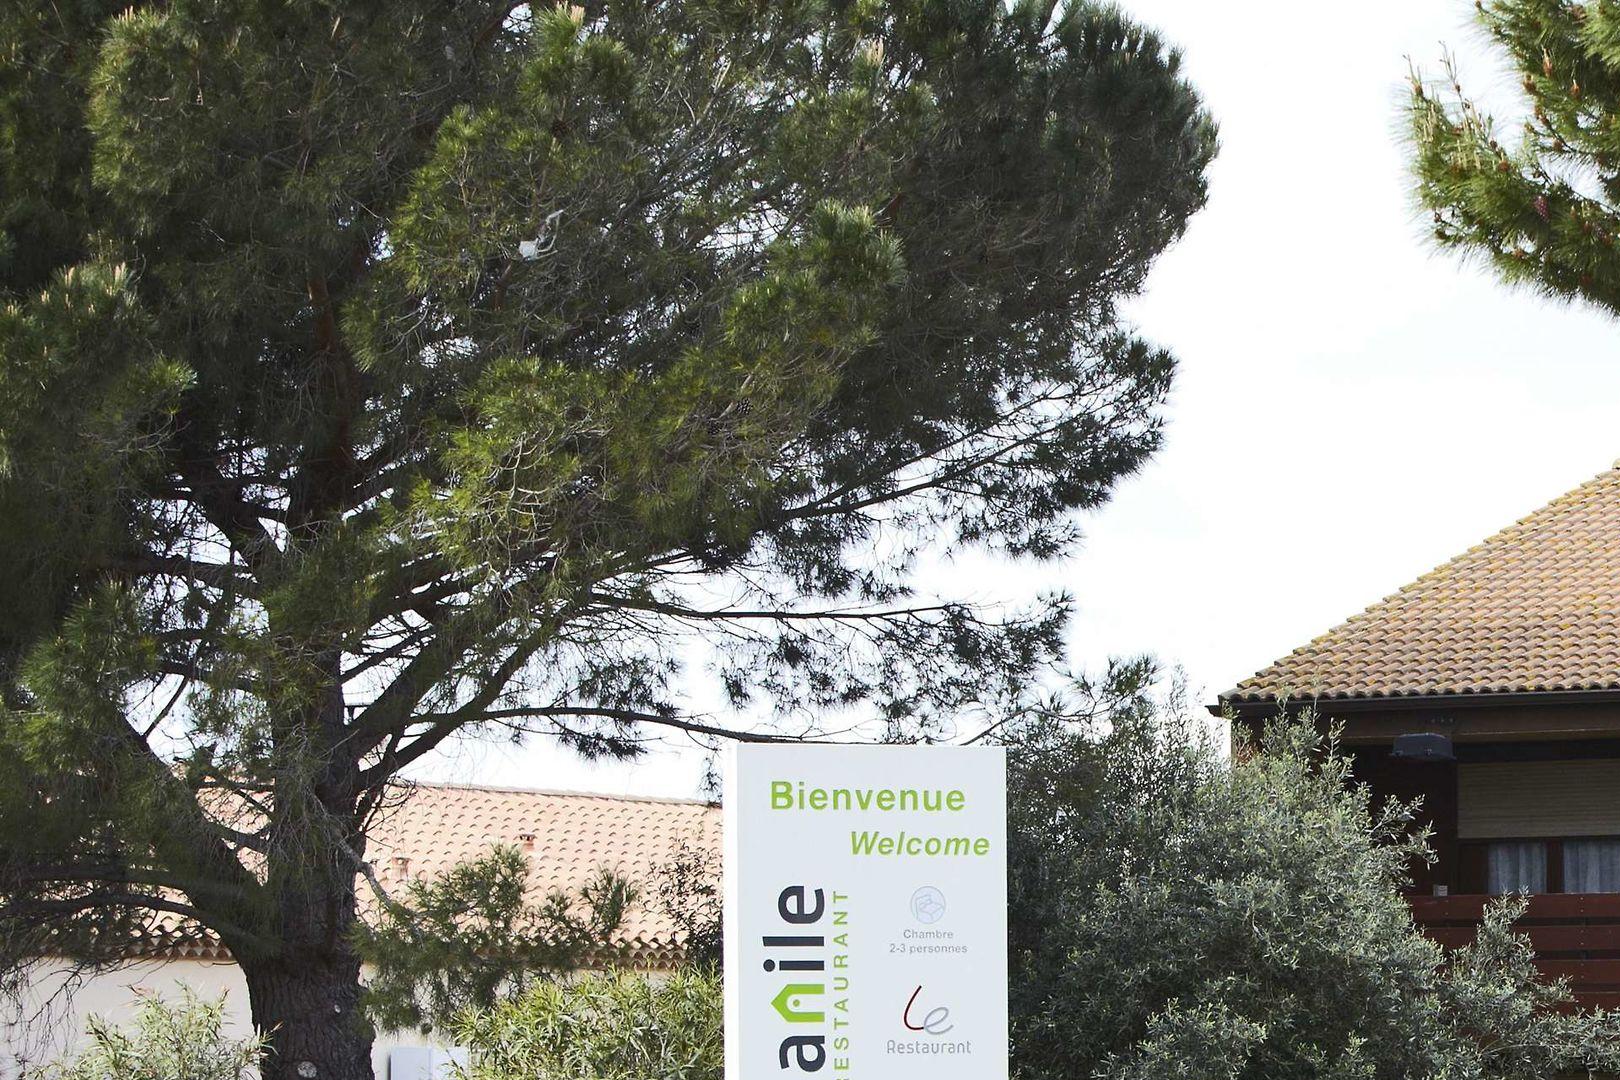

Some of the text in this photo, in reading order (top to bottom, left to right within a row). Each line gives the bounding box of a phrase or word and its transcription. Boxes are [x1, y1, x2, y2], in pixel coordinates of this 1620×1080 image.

[770, 781, 966, 812] Bienvenue
[850, 830, 991, 858] Welcome
[903, 929, 954, 939] Chambre
[889, 943, 968, 955] 2-3 personnes
[886, 1039, 972, 1055] Restaurant
